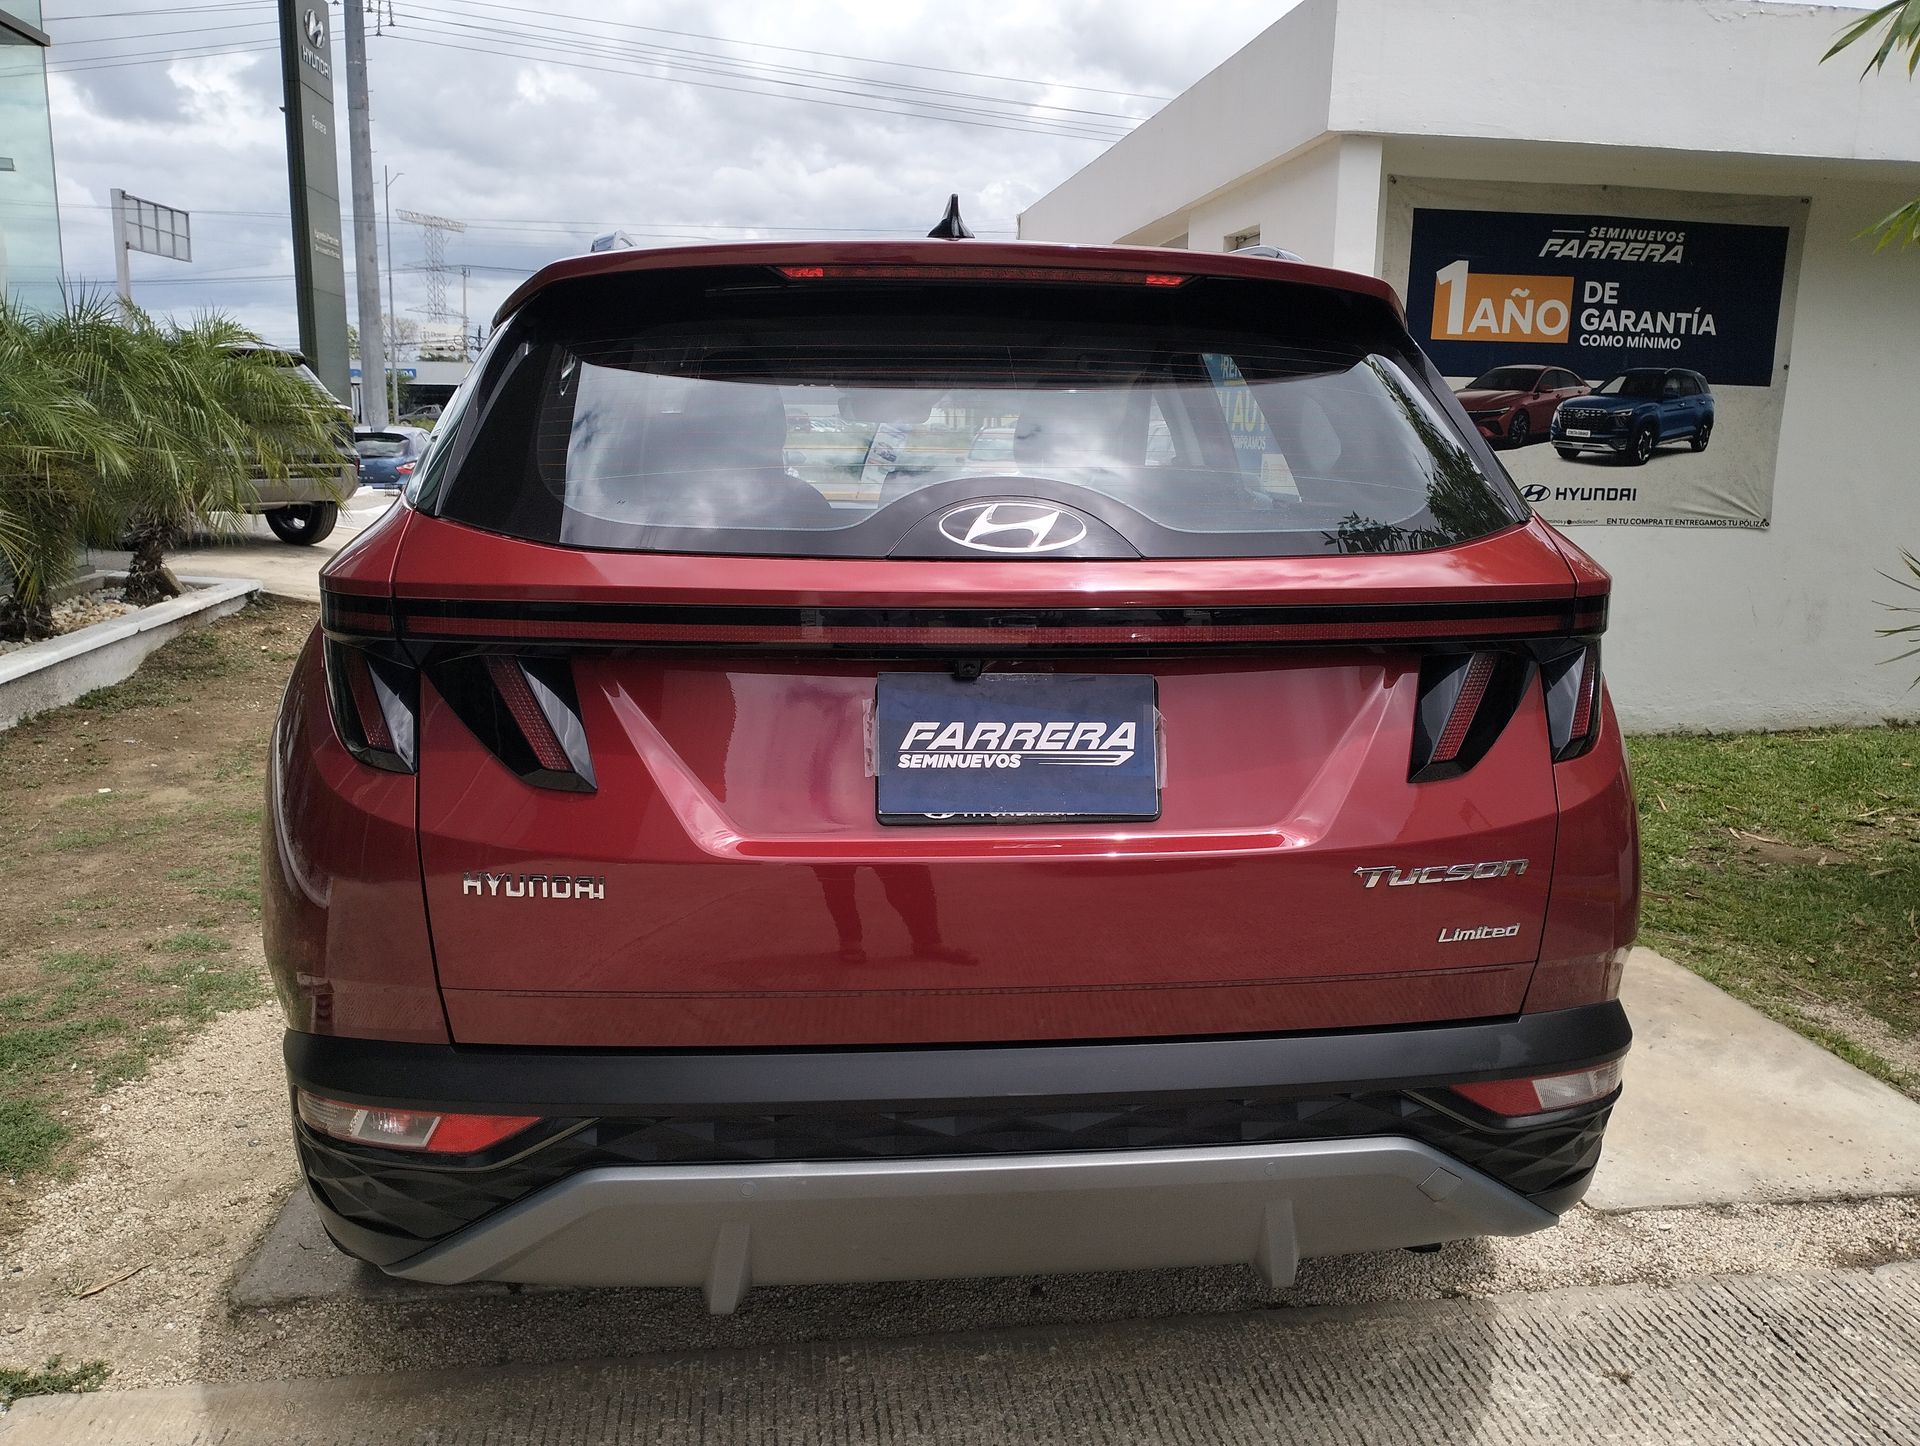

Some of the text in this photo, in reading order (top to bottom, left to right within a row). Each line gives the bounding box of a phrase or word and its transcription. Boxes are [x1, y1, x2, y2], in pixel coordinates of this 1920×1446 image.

[1588, 226, 1686, 243] SEMINUEVOS
[1538, 238, 1684, 264] FARRERA
[1436, 260, 1569, 336] 1 AÑO
[1583, 281, 1620, 305] DE
[1580, 306, 1717, 336] GARANTÍA
[1579, 333, 1682, 350] COMO MÍNIMO
[1555, 487, 1637, 502] HYUNDAI
[1606, 517, 1617, 525] EN
[1664, 518, 1674, 526] TE
[1674, 518, 1727, 527] ENTREGAMOS
[1728, 519, 1738, 527] TU
[899, 722, 1136, 750] FARRERA
[898, 754, 1021, 769] SEMINUEVOS
[1354, 858, 1530, 888] TUCSON
[463, 872, 605, 900] HYUNDAI
[1438, 923, 1521, 943] Limited
